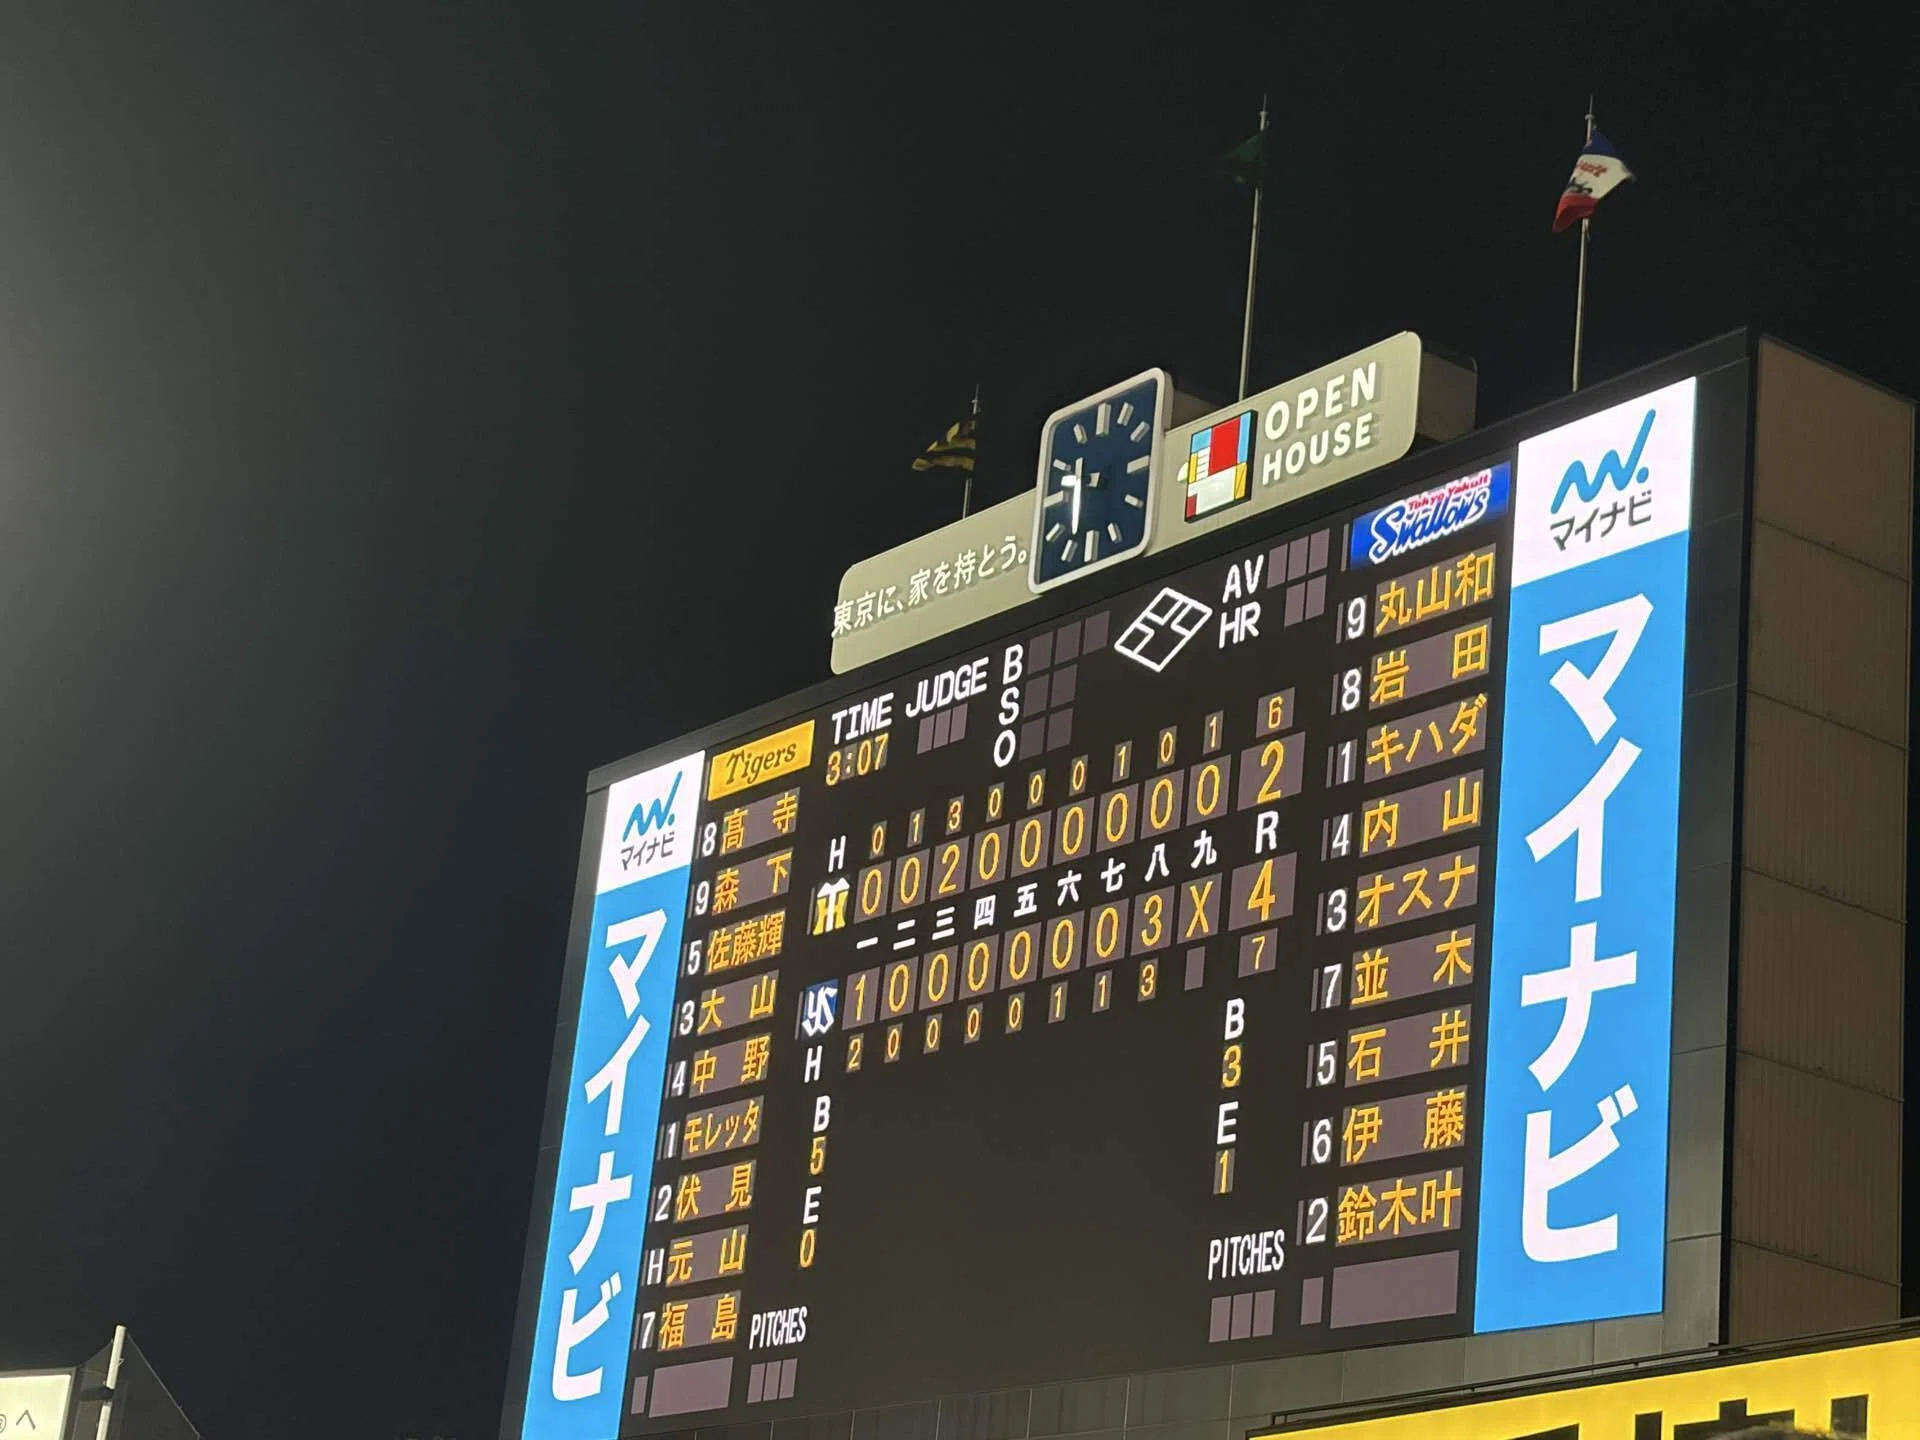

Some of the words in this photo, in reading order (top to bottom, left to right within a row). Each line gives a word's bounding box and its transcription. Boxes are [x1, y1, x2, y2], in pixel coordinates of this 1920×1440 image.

[1264, 362, 1376, 440] OPEN
[1262, 413, 1372, 485] HOUSE
[1408, 491, 1444, 510] Tokyo
[1448, 474, 1488, 494] Yakult
[1369, 487, 1490, 564] Swallows
[1550, 489, 1652, 551] マイナビ
[832, 536, 1028, 638] 東京に、家を持とう。
[1222, 554, 1264, 606] AV
[1347, 597, 1366, 639] 9
[1376, 552, 1494, 637] 丸山和
[1218, 598, 1261, 649] HR
[905, 656, 989, 718] JUDGE
[1002, 644, 1024, 685] B
[998, 686, 1020, 726] S
[1341, 668, 1361, 711] 8
[831, 692, 894, 745] TIME
[1341, 741, 1351, 783] 1
[1366, 691, 1487, 774] キハダ
[726, 743, 796, 784] Tigers
[826, 734, 889, 786] 3:07
[828, 835, 846, 873] H
[871, 826, 885, 856] 0
[911, 813, 921, 843] 1
[948, 801, 962, 830] 3
[989, 789, 1002, 818] 0
[1030, 775, 1043, 804] 0
[1071, 761, 1085, 791] 0
[1117, 746, 1128, 777] 1
[1160, 733, 1174, 763] 0
[1208, 718, 1219, 748] 1
[1267, 697, 1283, 729] 6
[621, 831, 674, 871] マイナビ
[701, 822, 717, 857] 8
[861, 868, 883, 916] 0
[900, 857, 921, 905] 0
[938, 844, 961, 894] 2
[978, 832, 1000, 881] 0
[1020, 819, 1042, 868] 0
[1062, 806, 1085, 856] 0
[1105, 792, 1129, 843] 0
[1150, 778, 1174, 830] 0
[1196, 764, 1221, 817] 0
[1256, 740, 1285, 804] 2
[1332, 814, 1350, 856] 4
[695, 880, 710, 915] 9
[893, 919, 916, 950] 二
[932, 906, 955, 941] 三
[973, 894, 996, 930] 四
[1013, 882, 1038, 918] 五
[1057, 869, 1082, 906] 六
[1100, 857, 1126, 893] 七
[1144, 843, 1170, 882] 八
[1190, 829, 1217, 869] 九
[1255, 810, 1279, 854] R
[1327, 888, 1347, 932] 3
[1356, 856, 1476, 928] オスナ
[687, 939, 702, 975] 5
[706, 908, 785, 972] 佐藤輝
[855, 974, 867, 1022] 1
[888, 963, 910, 1013] 0
[928, 953, 949, 1002] 0
[967, 942, 990, 992] 0
[1009, 930, 1031, 981] 0
[1052, 919, 1075, 970] 0
[1095, 907, 1119, 959] 0
[1141, 895, 1163, 946] 3
[1185, 882, 1212, 938] X
[1247, 859, 1276, 921] 4
[1521, 593, 1654, 1262] マイナビ
[1323, 963, 1342, 1009] 7
[679, 999, 695, 1036] 3
[804, 1045, 823, 1083] H
[847, 1040, 862, 1068] 2
[886, 1029, 900, 1058] 0
[926, 1019, 940, 1049] 0
[967, 1008, 981, 1038] 0
[1007, 997, 1022, 1027] 0
[1053, 988, 1064, 1018] 1
[1097, 976, 1108, 1008] 1
[1140, 964, 1155, 997] 3
[1250, 937, 1266, 971] 7
[1224, 997, 1245, 1040] B
[671, 1060, 687, 1096] 4
[1222, 1044, 1242, 1088] 3
[1317, 1040, 1336, 1086] 5
[667, 1122, 677, 1158] 1
[683, 1102, 760, 1153] モレッタ
[813, 1095, 831, 1133] B
[1216, 1101, 1239, 1145] E
[550, 908, 668, 1402] マイナビ
[810, 1137, 825, 1175] 5
[1312, 1118, 1332, 1164] 6
[1217, 1150, 1230, 1195] 1
[654, 1184, 672, 1222] 2
[803, 1186, 822, 1225] E
[1305, 1197, 1329, 1244] 2
[1337, 1171, 1462, 1244] 鈴木叶
[646, 1248, 665, 1286] H
[799, 1230, 815, 1268] 0
[1207, 1229, 1285, 1281] PITCHES
[641, 1311, 656, 1349] 7
[749, 1306, 808, 1350] PITCHES
